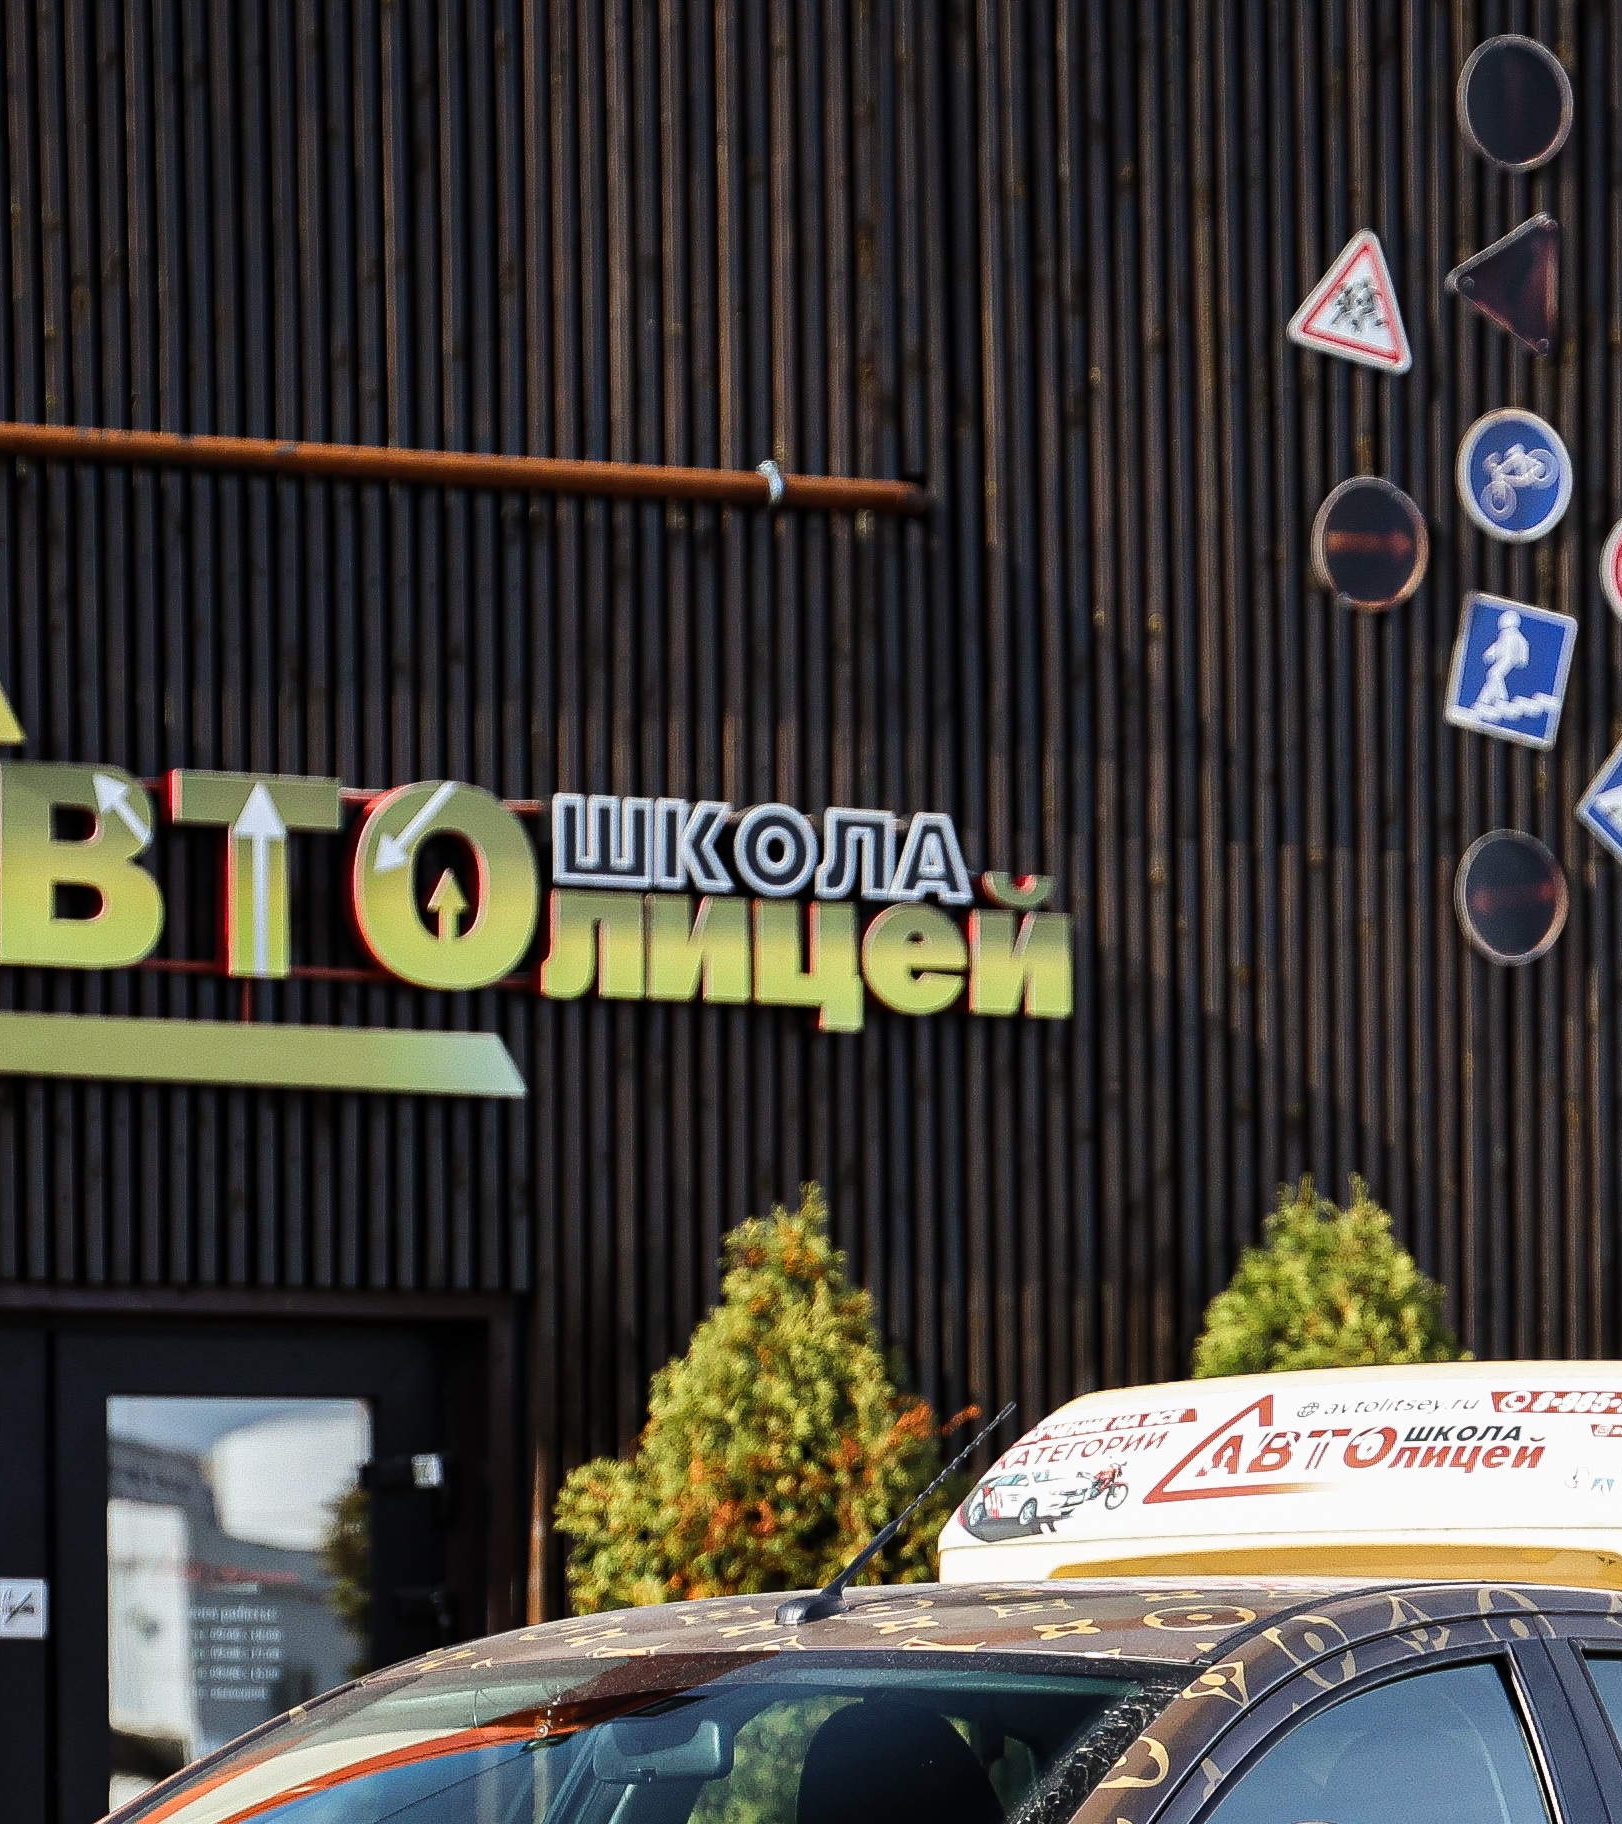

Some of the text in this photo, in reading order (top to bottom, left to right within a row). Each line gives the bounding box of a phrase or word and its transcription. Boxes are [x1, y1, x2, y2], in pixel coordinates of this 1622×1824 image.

[551, 793, 973, 904] ШКОЛА
[541, 871, 1074, 1033] лицей
[1324, 1397, 1480, 1416] avtolitsey.ru
[994, 1431, 1169, 1472] КАТЕГОРИИ
[1195, 1426, 1522, 1477] АВТО ШКОЛА
[1387, 1437, 1547, 1474] лицей
